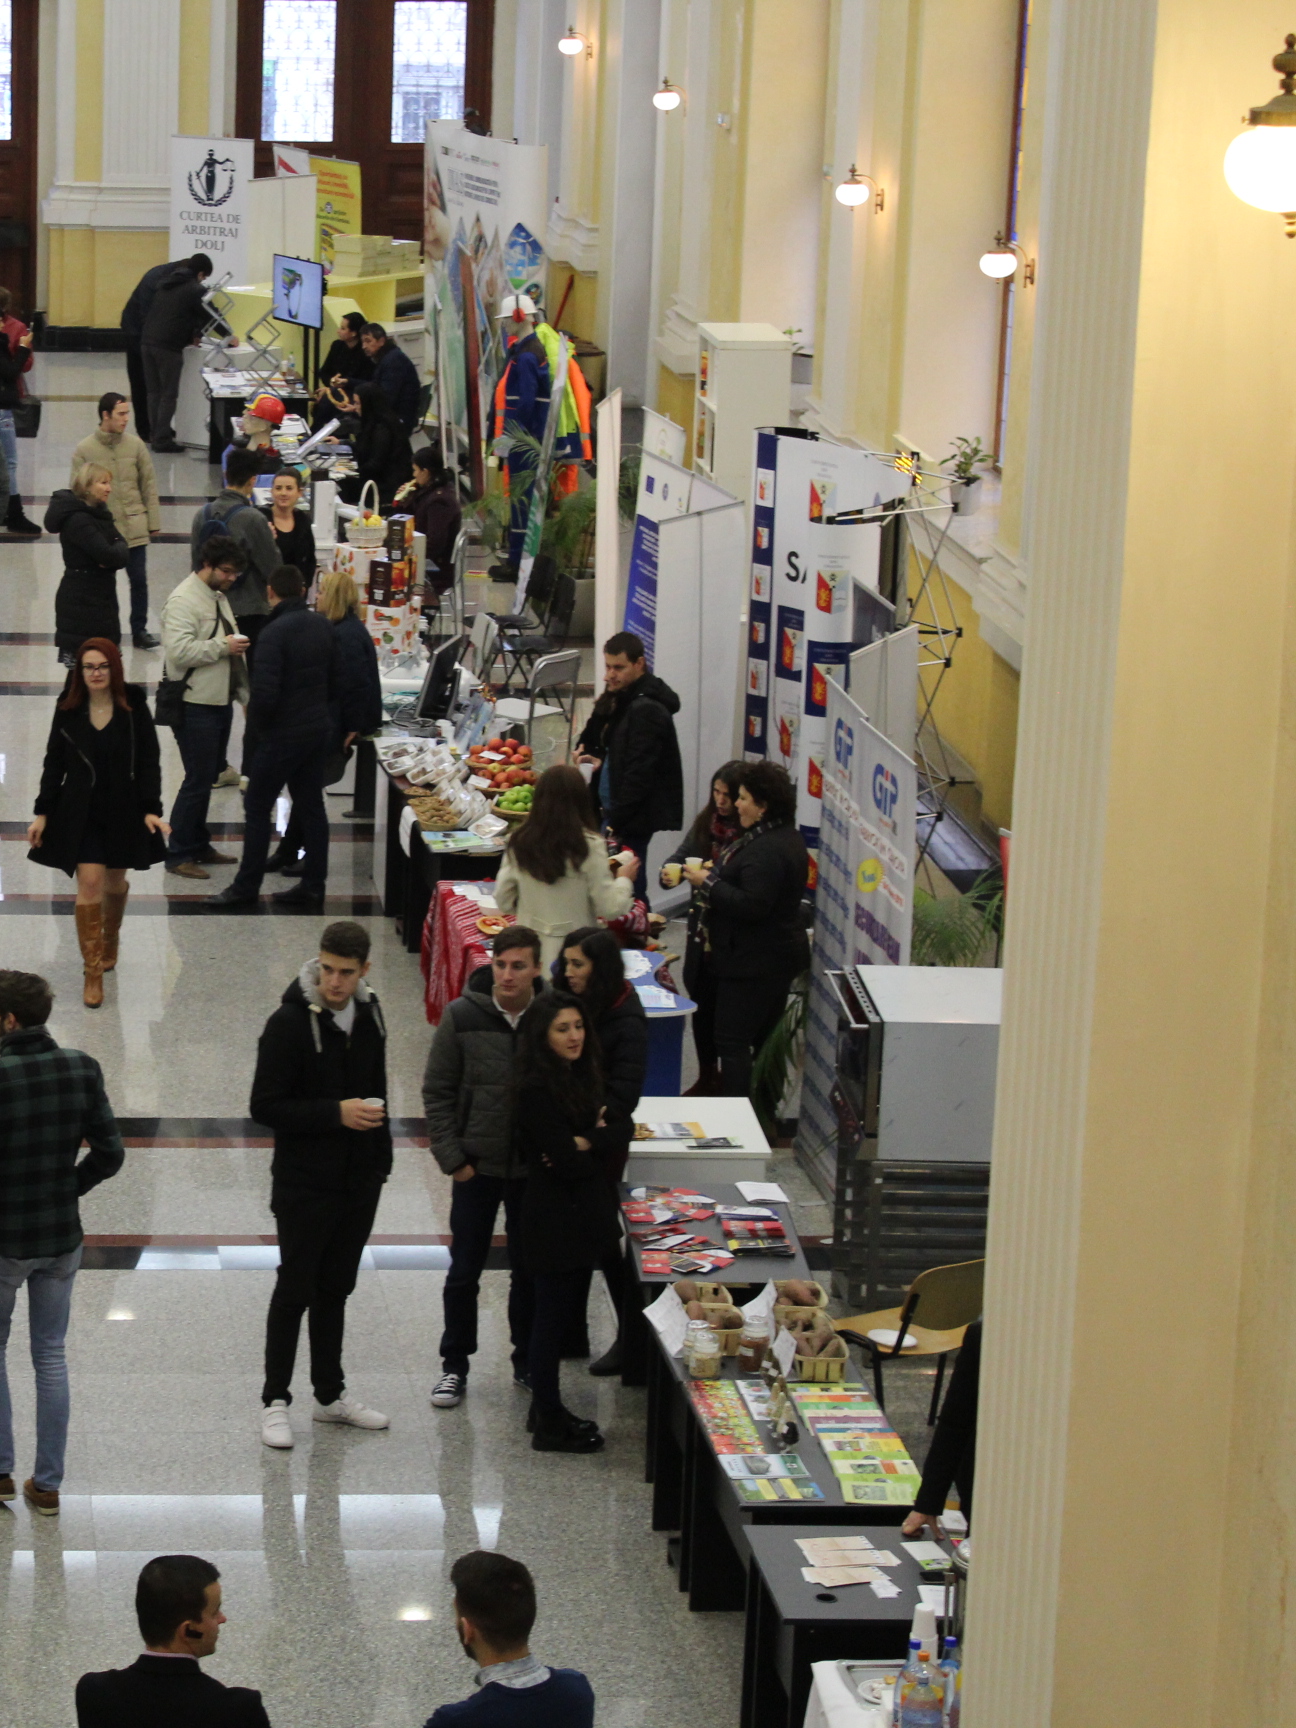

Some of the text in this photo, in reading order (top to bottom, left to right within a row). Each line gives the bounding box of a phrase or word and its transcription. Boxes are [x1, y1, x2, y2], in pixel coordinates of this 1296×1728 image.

[179, 211, 241, 224] CURTEA DE
[182, 224, 239, 239] ARBITRAJ
[194, 238, 225, 252] DOLJ
